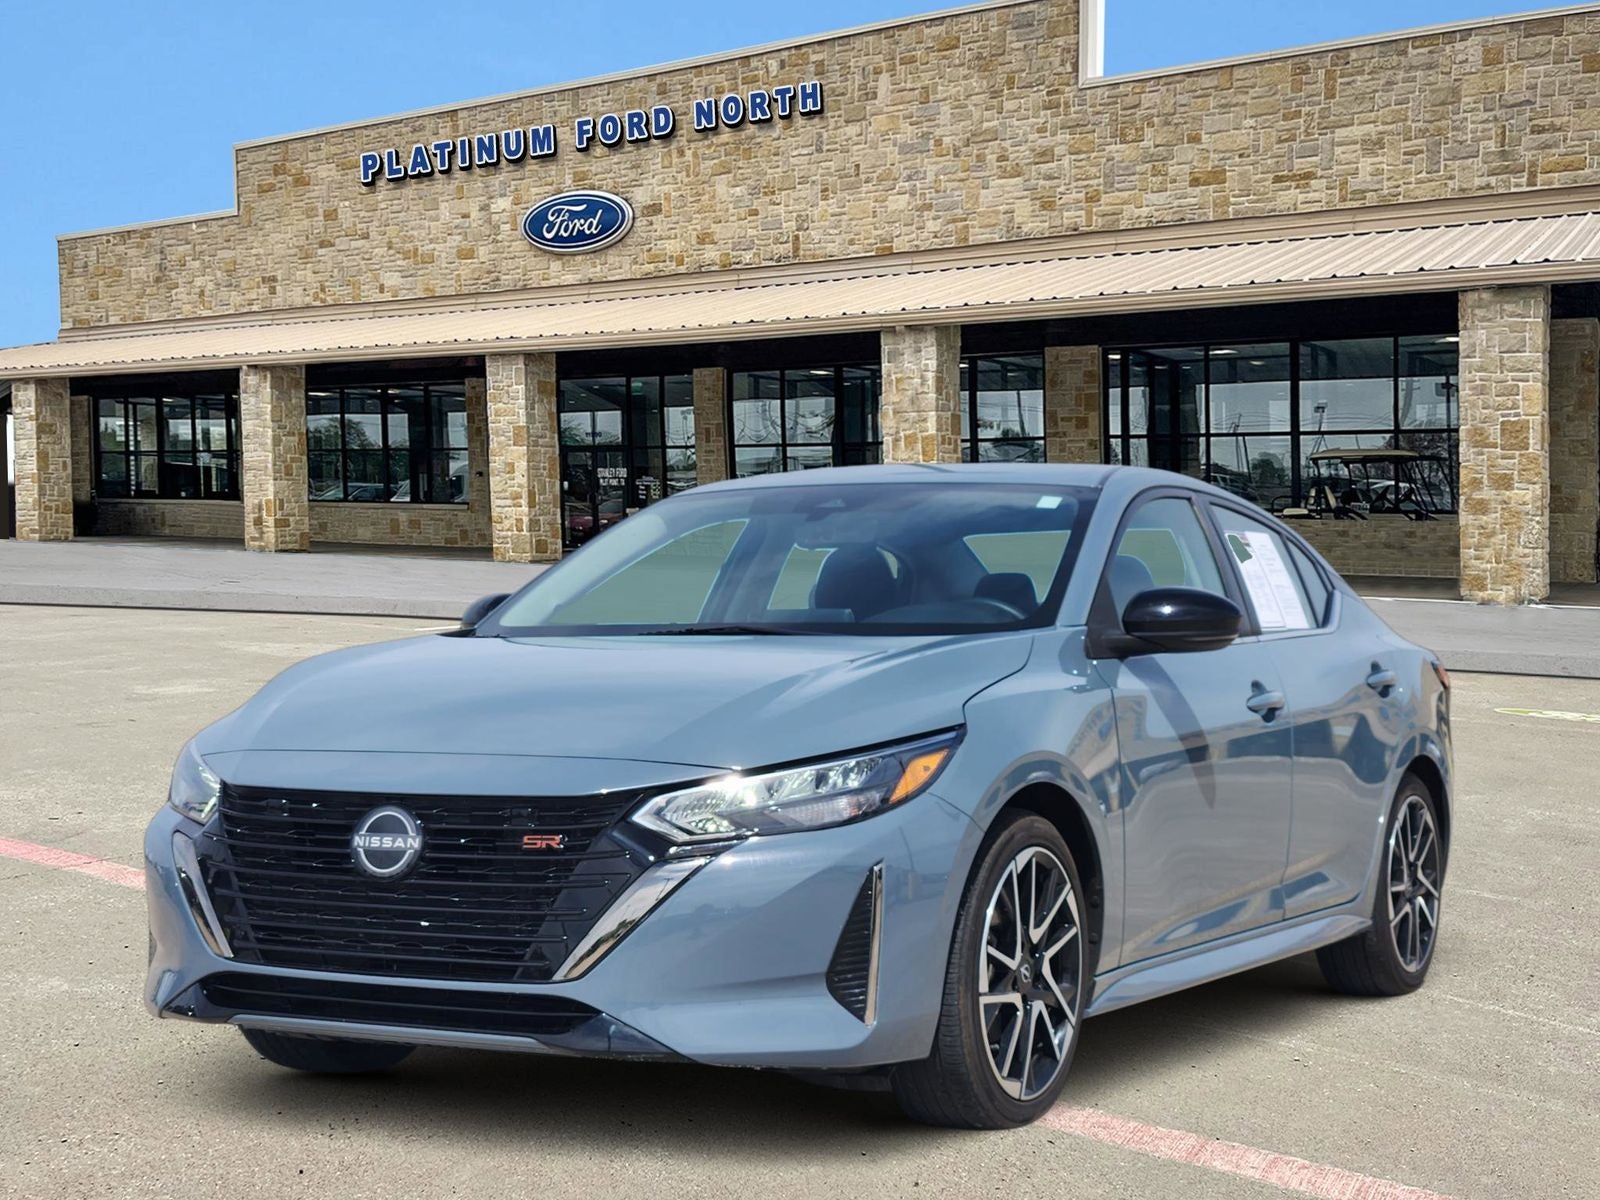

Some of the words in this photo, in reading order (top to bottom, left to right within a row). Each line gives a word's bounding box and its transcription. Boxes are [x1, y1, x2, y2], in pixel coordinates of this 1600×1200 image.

[360, 124, 556, 186] PLATINUM
[575, 104, 675, 151] FORD
[693, 81, 824, 132] NORTH
[542, 203, 602, 240] Ford
[354, 836, 420, 848] NISSAN
[523, 835, 563, 849] SR
